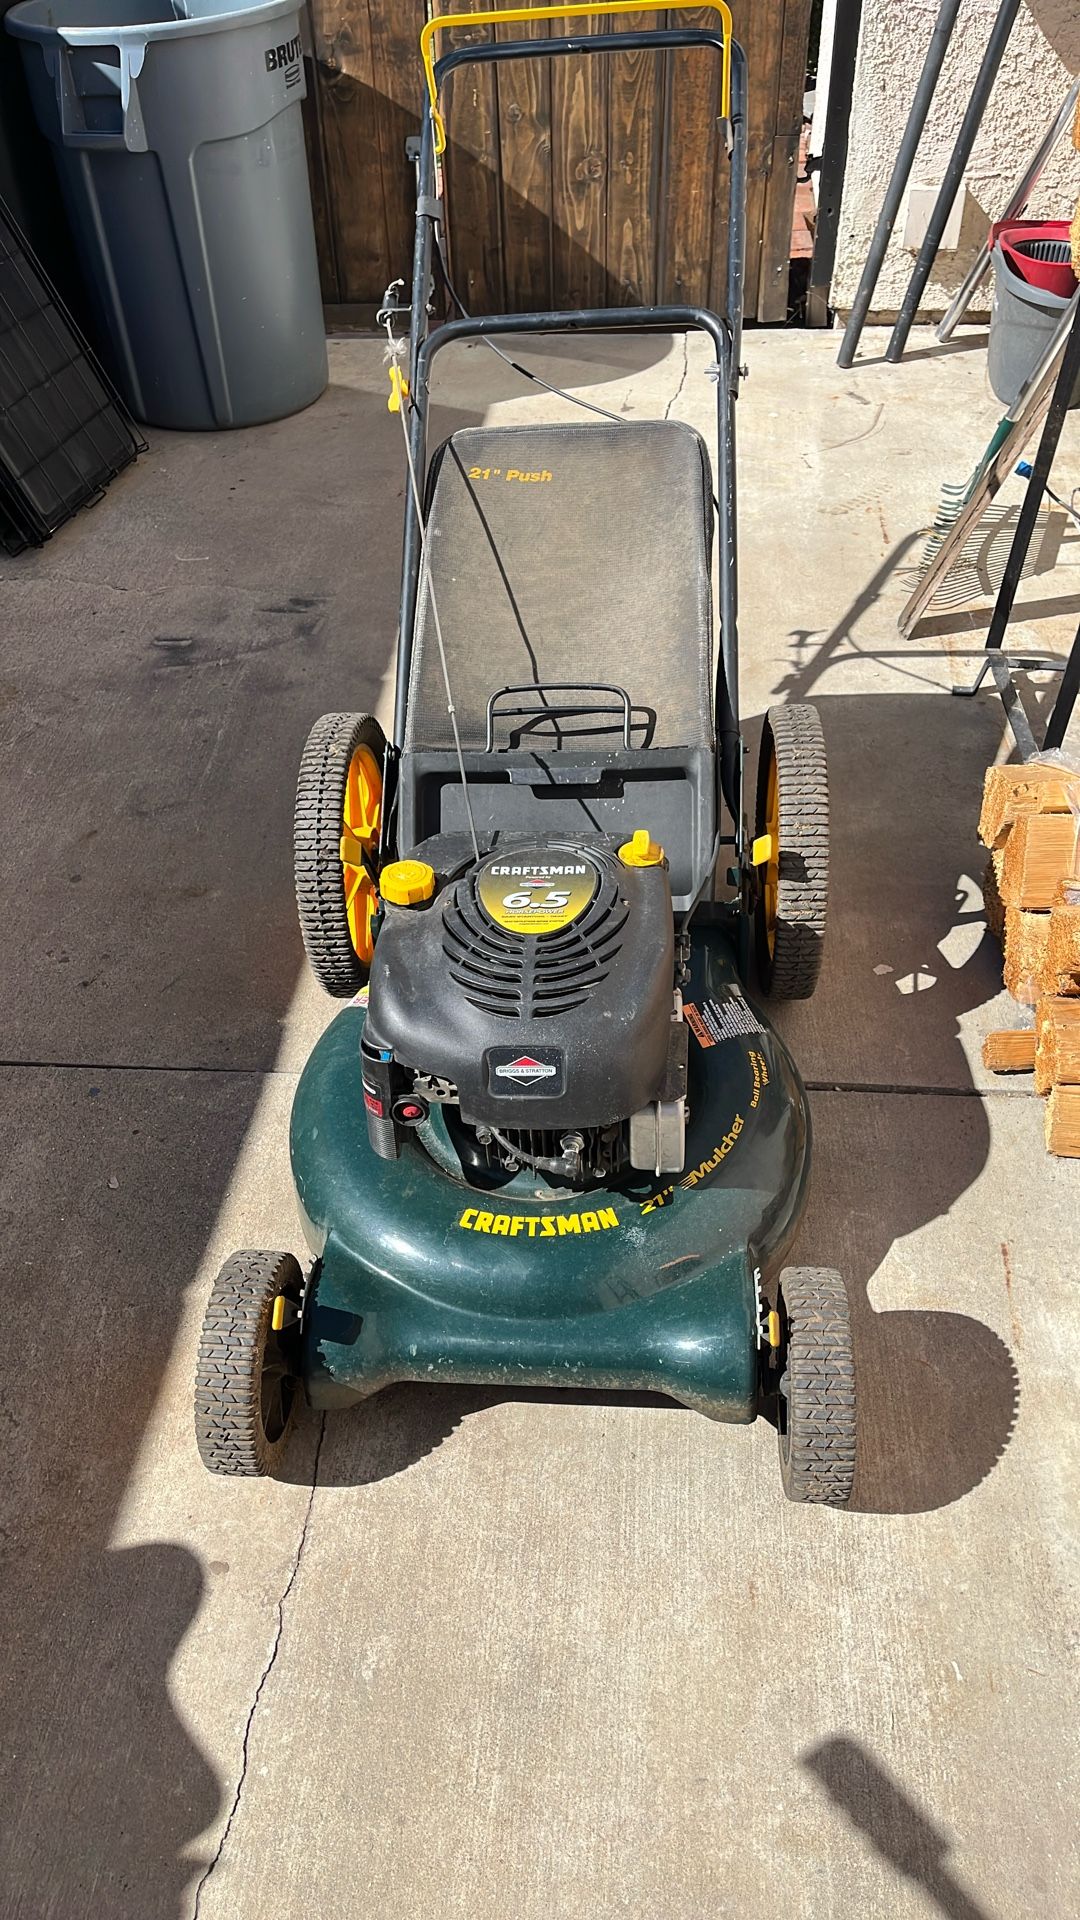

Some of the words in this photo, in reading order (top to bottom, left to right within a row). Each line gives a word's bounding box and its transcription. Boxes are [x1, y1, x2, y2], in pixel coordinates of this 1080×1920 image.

[468, 467, 501, 480] 21"
[506, 469, 553, 482] Push
[491, 865, 586, 875] CRAFTSMAN
[503, 891, 571, 908] 6.5
[748, 1051, 760, 1088] Bearing
[750, 1087, 760, 1108] Ball
[640, 1185, 674, 1216] 21"
[688, 1113, 745, 1186] Mulcher
[459, 1207, 620, 1237] CRAFTSMAN
